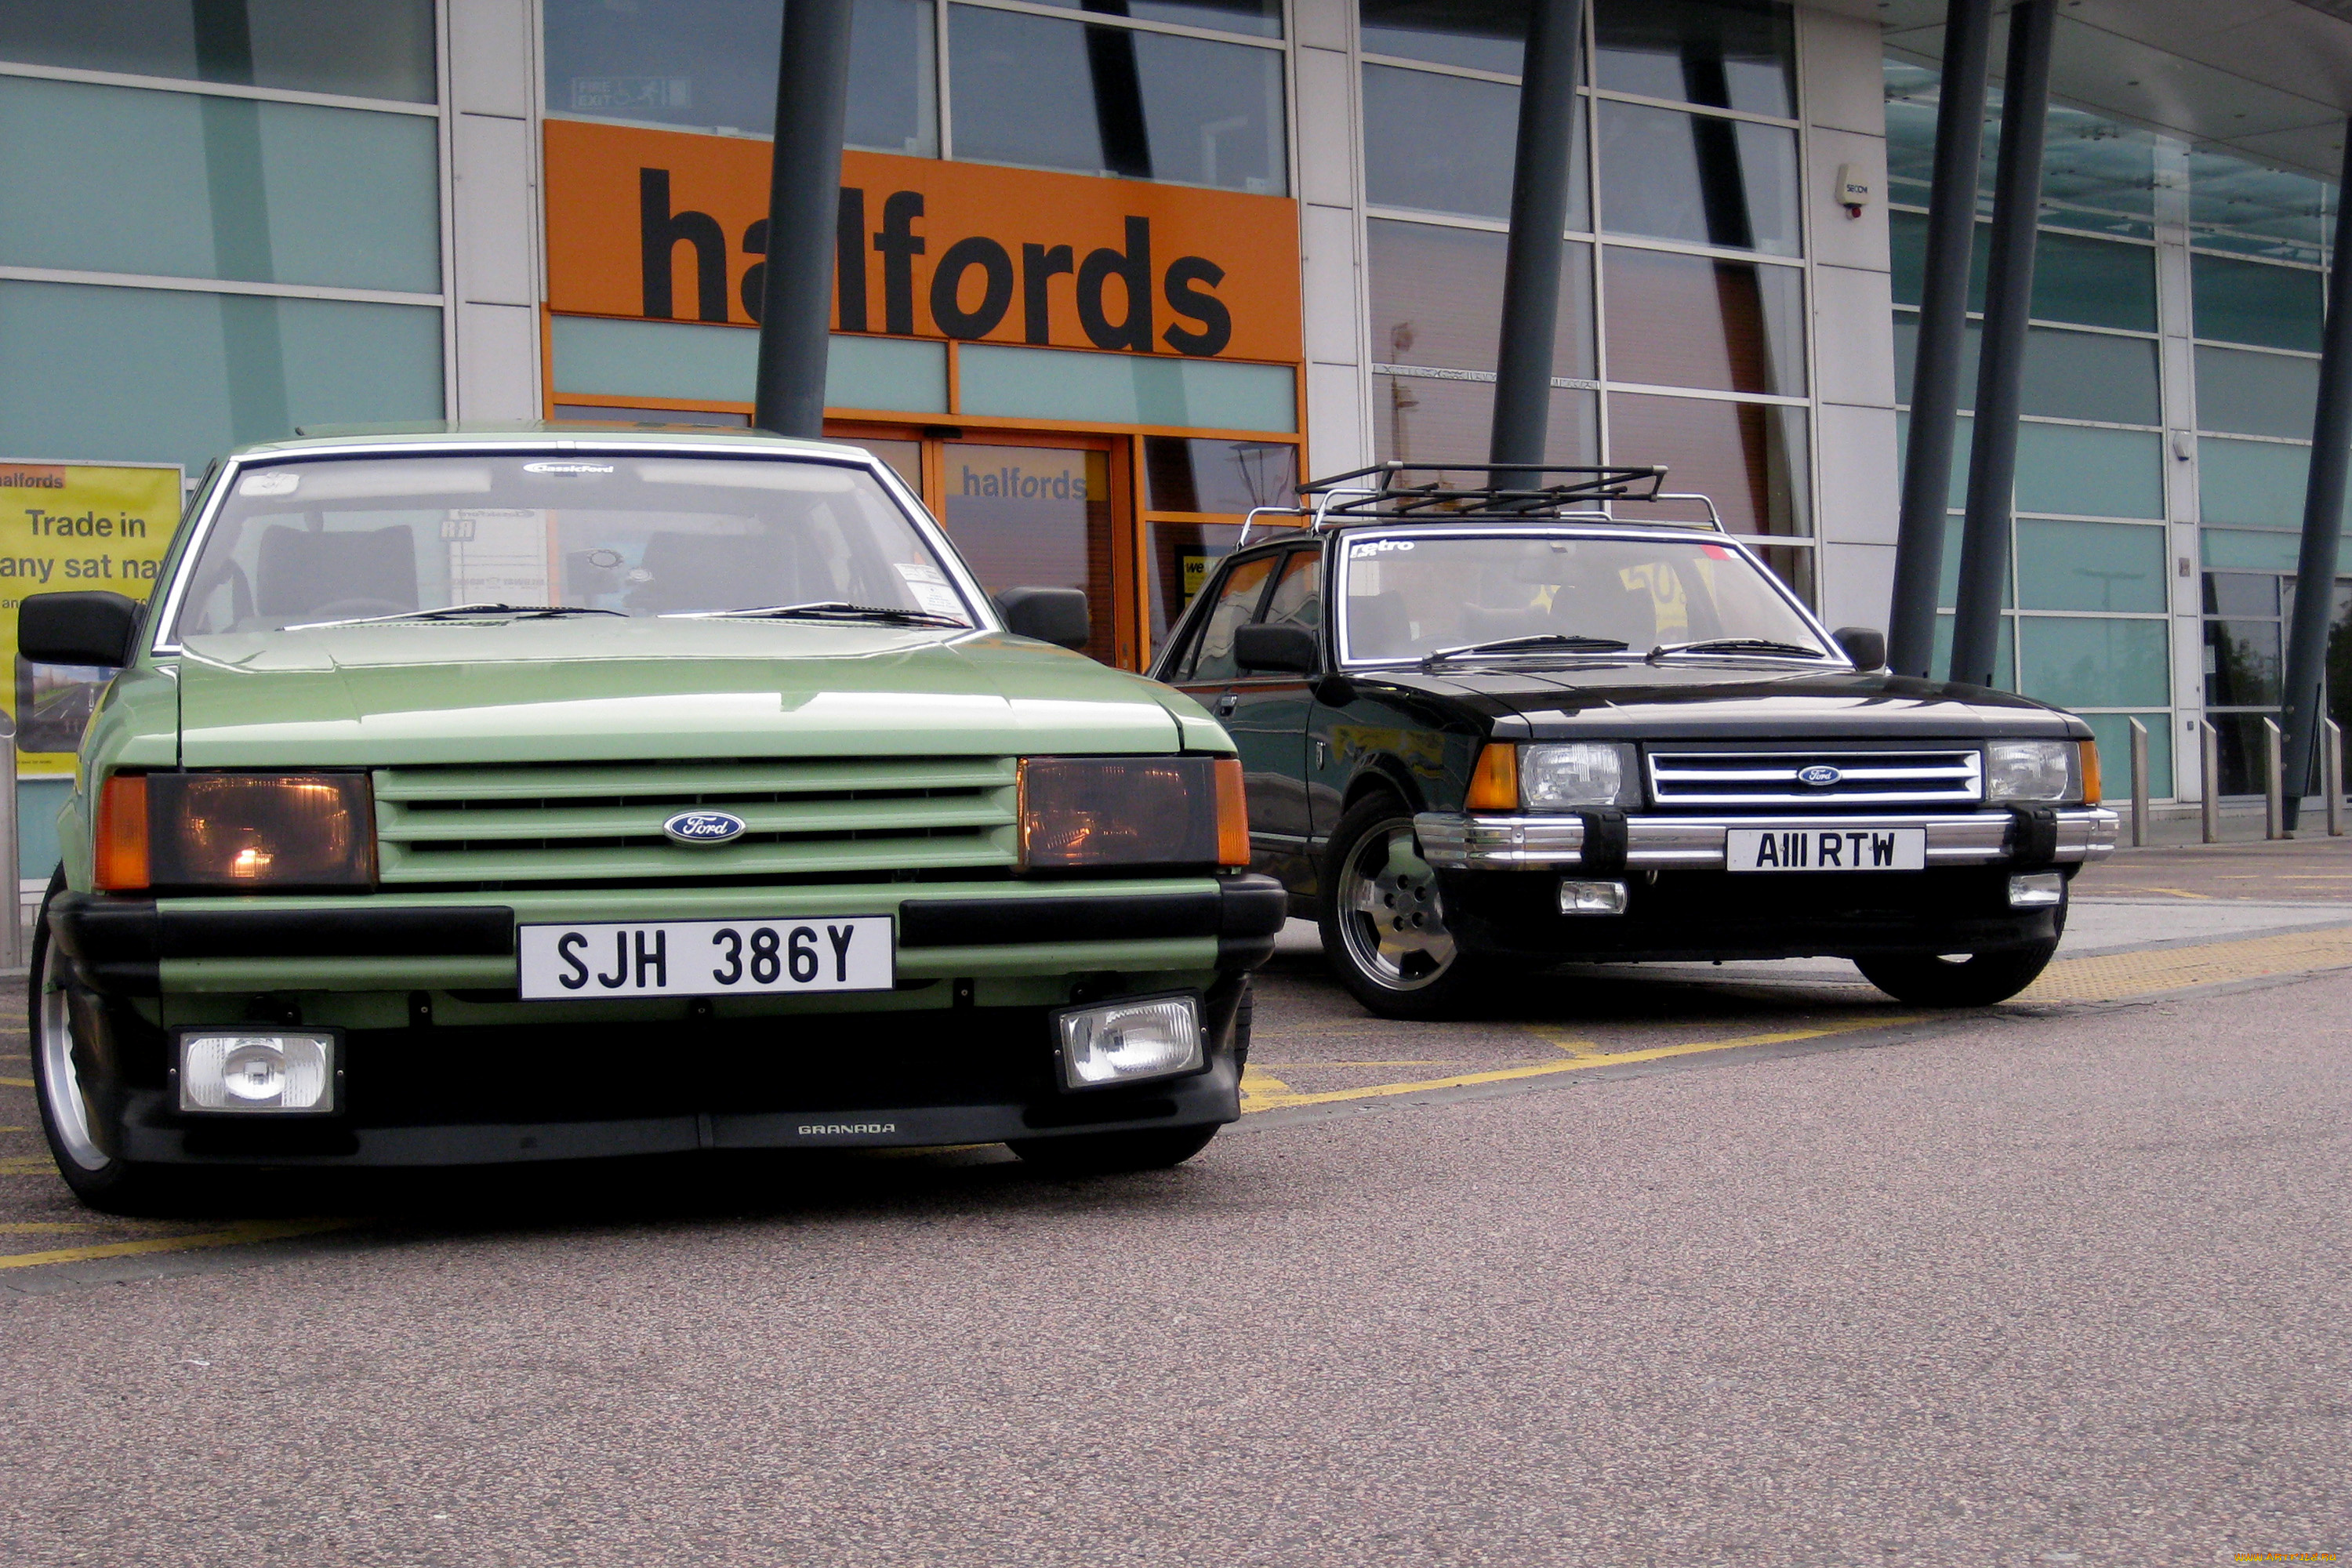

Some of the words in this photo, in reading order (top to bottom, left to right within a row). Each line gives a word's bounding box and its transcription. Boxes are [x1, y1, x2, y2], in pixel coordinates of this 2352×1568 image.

[0, 473, 64, 489] alfords
[963, 465, 1088, 500] halfords
[25, 509, 113, 537] Trade
[120, 511, 147, 538] in
[1351, 539, 1415, 555] retro
[0, 556, 55, 584] any
[64, 554, 113, 579] sat
[122, 558, 162, 579] na
[1185, 563, 1204, 573] we
[2, 597, 21, 608] an
[1808, 769, 1832, 782] Ford
[683, 815, 728, 836] Ford
[1818, 832, 1895, 867] RTW
[557, 929, 666, 989] SJH
[712, 924, 854, 985] 386Y
[798, 1123, 895, 1134] GRANADA
